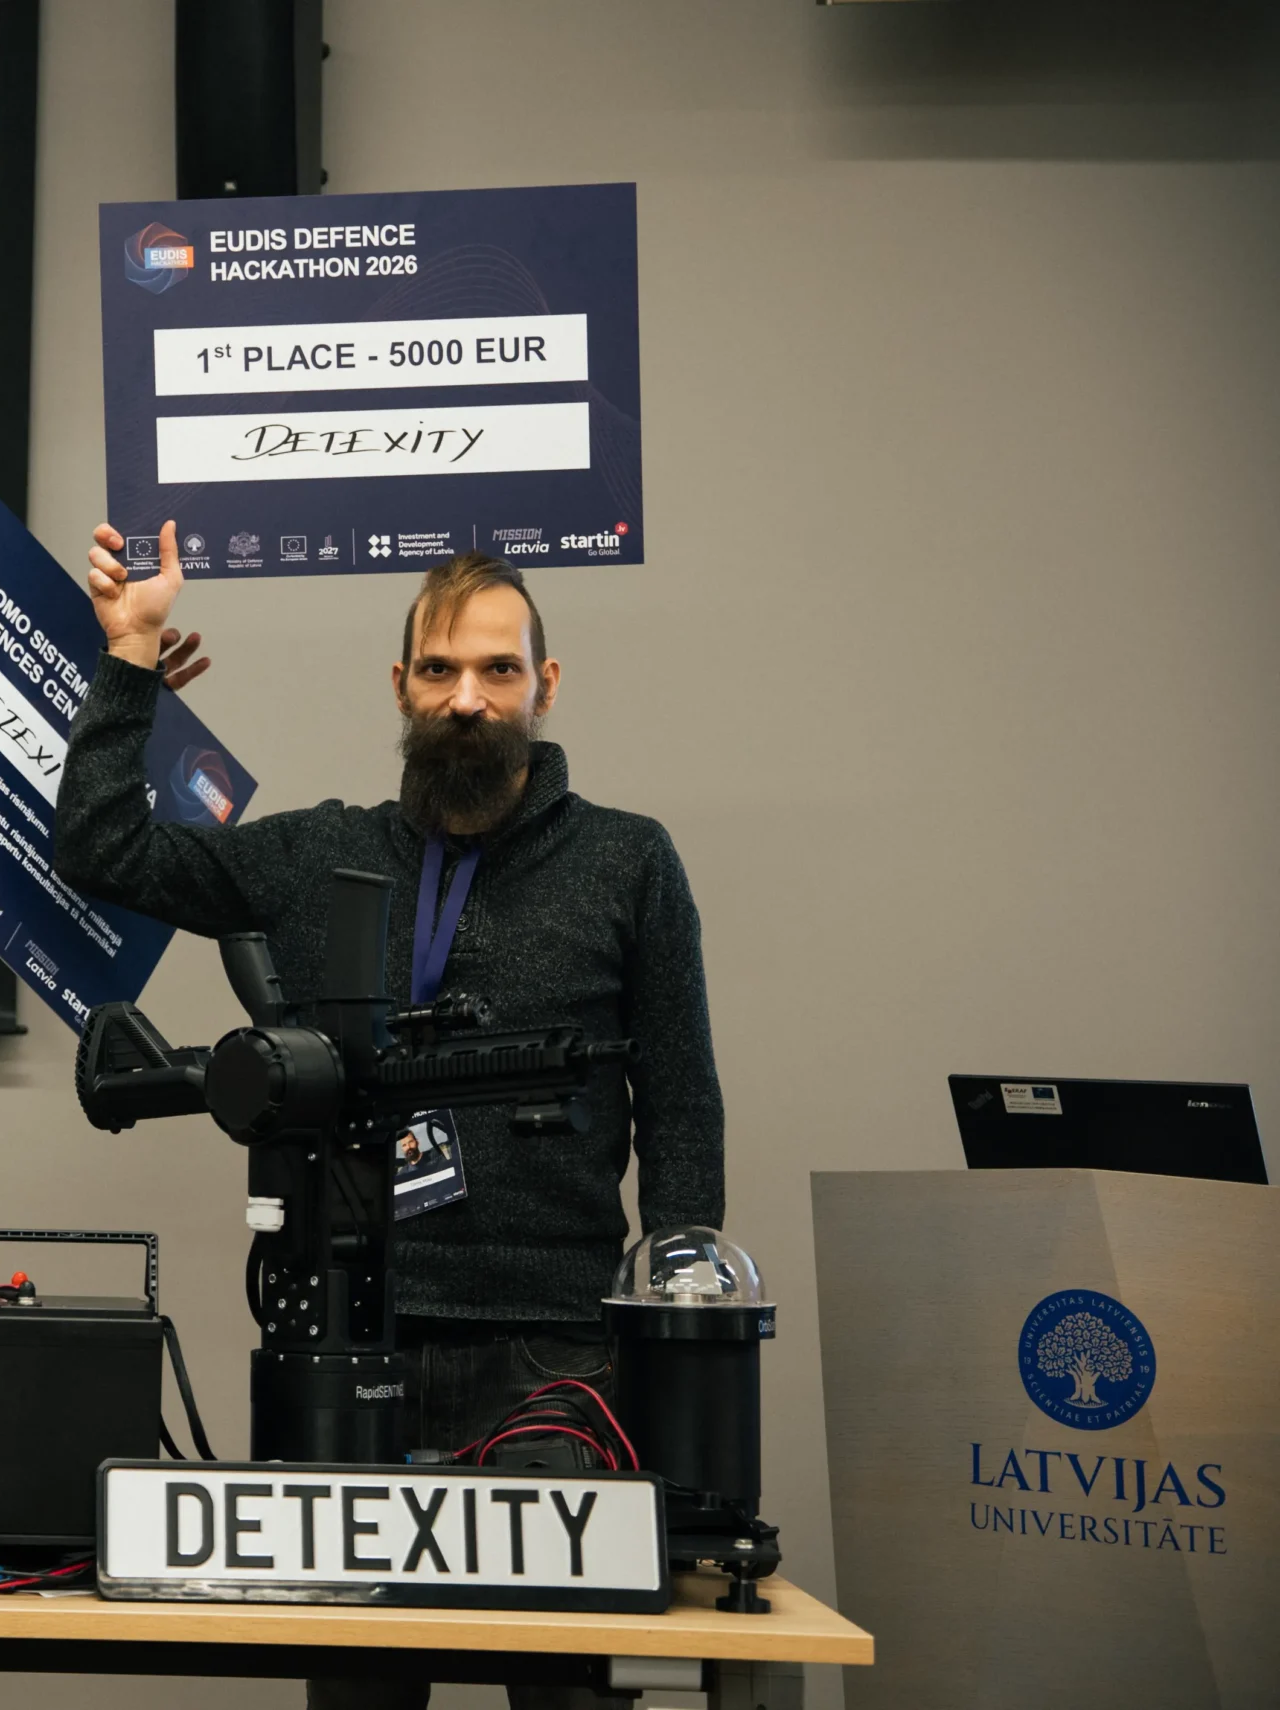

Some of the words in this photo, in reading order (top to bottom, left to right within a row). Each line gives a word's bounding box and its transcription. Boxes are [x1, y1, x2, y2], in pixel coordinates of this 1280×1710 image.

[150, 249, 188, 261] EUDIS
[210, 229, 287, 252] EUDIS
[294, 224, 416, 250] DEFENCE
[210, 257, 360, 282] HACKATHON
[366, 255, 418, 276] 2026
[197, 343, 232, 373] 1st
[243, 343, 356, 372] PLACE
[389, 340, 463, 367] 5000
[476, 336, 547, 363] EUR
[319, 546, 338, 555] 2027
[399, 540, 444, 549] Development
[399, 548, 423, 556] Agency
[493, 528, 542, 541] MISSION
[504, 541, 549, 554] Latvia
[560, 531, 619, 549] startin
[30, 630, 88, 699] SISTĒM
[43, 679, 78, 720] CEN
[197, 775, 226, 810] EUDIS
[9, 793, 48, 837] risinājumu.
[10, 829, 48, 871] risinājuma
[88, 911, 121, 946] militārajā
[21, 857, 69, 909] konsultācijas
[70, 907, 79, 919] tā
[79, 917, 116, 957] turpmākai
[25, 940, 58, 975] MISSION
[26, 957, 56, 990] Latvia
[61, 989, 90, 1020] start
[1025, 1297, 1083, 1348] UNIVERSITAS
[1092, 1299, 1147, 1356] LATVIENSIS
[1140, 1365, 1150, 1373] 19
[1027, 1373, 1080, 1422] SCIENTIAE
[1088, 1415, 1099, 1423] ET
[1106, 1382, 1145, 1420] PATRIAE
[970, 1443, 1227, 1513] LATVIJAS
[164, 1482, 599, 1577] DETEXITY
[970, 1502, 1228, 1555] UNIVERSITĀTE
